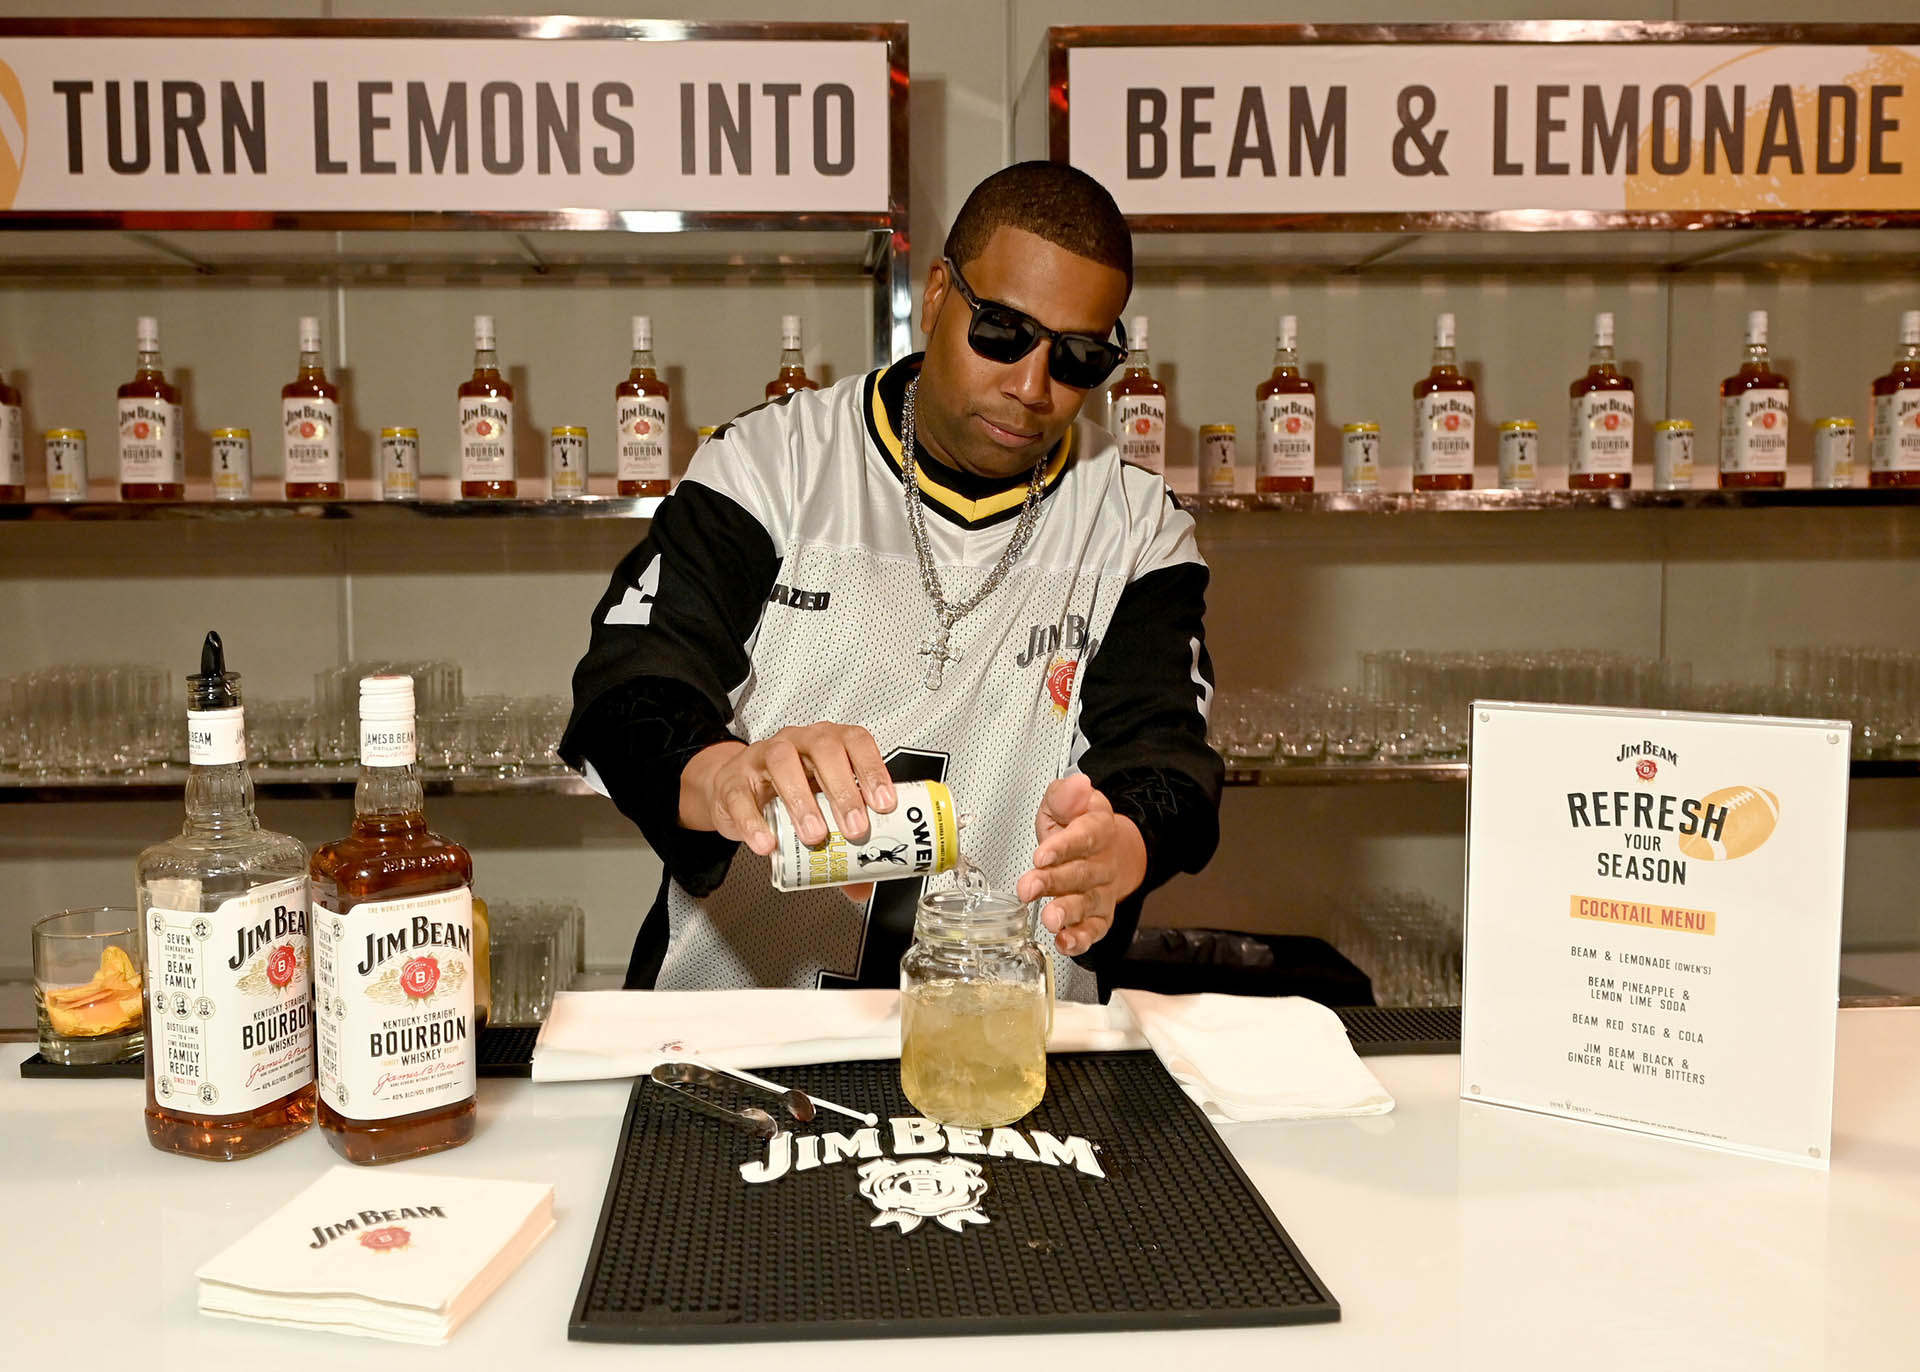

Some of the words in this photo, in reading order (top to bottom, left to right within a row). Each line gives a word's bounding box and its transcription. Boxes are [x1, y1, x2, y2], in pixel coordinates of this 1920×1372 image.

[52, 80, 267, 176] TURN
[312, 80, 635, 176] LEMONS
[679, 82, 857, 177] INTO
[1126, 85, 1347, 180] BEAM
[1392, 84, 1450, 178] &
[1492, 83, 1903, 176] LEMONADE
[137, 406, 166, 426] BEAM
[304, 405, 332, 426] BEAM
[462, 408, 478, 425] JIM
[480, 404, 507, 424] BEAM
[620, 407, 636, 424] JIM
[639, 404, 665, 424] BEAM
[465, 447, 504, 457] BOURBON
[623, 446, 662, 456] BOURBON
[1123, 444, 1160, 454] BOURBON
[364, 731, 388, 747] JAMES
[1616, 743, 1641, 762] JIM
[1643, 740, 1678, 767] BEAM
[1567, 791, 1728, 842] REFRESH
[1624, 833, 1661, 851] YOUR
[1597, 852, 1686, 885] SEASON
[1579, 899, 1653, 924] COCKTAIL
[1661, 909, 1706, 930] MENU
[167, 933, 191, 945] SEVEN
[228, 918, 272, 971] JIM
[357, 928, 408, 977] JIM
[412, 915, 471, 957] BEAM
[168, 960, 192, 975] BEAM
[1571, 945, 1597, 959] BEAM
[1604, 950, 1611, 961] &
[1619, 952, 1671, 970] LEMONADE
[165, 974, 197, 989] FAMILY
[415, 971, 426, 984] B
[1588, 976, 1615, 989] BEAM
[1622, 981, 1675, 999] PINEAPPLE
[1682, 990, 1690, 1001] &
[253, 1004, 283, 1021] KENTUCKY
[284, 992, 307, 1010] STRAIGHT
[1591, 989, 1622, 1003] LEMON
[1630, 995, 1652, 1008] LIME
[1660, 999, 1686, 1012] SODA
[167, 1022, 199, 1034] DISTILLING
[383, 1016, 421, 1030] KENTUCKY
[424, 1007, 456, 1023] STRAIGHT
[1572, 1013, 1599, 1026] BEAM
[1606, 1018, 1624, 1031] RED
[1631, 1022, 1656, 1036] STAG
[1663, 1028, 1671, 1039] &
[1678, 1030, 1704, 1044] COLA
[268, 1034, 298, 1055] WHISKEY
[370, 1015, 466, 1057] BOURBON
[168, 1047, 200, 1063] FAMILY
[401, 1048, 442, 1066] WHISKEY
[1584, 1043, 1600, 1054] JIM
[1608, 1046, 1635, 1060] BEAM
[1642, 1052, 1674, 1067] BLACK
[1682, 1058, 1689, 1069] &
[170, 1061, 200, 1077] RECIPE
[1568, 1051, 1602, 1067] GINGER
[1608, 1059, 1625, 1071] ALE
[1632, 1063, 1657, 1077] WITH
[1665, 1069, 1705, 1085] BITTERS
[738, 1127, 884, 1184] JIM
[888, 1116, 1106, 1179] BEAM
[309, 1218, 360, 1249] JIM
[358, 1206, 449, 1226] BEAM
